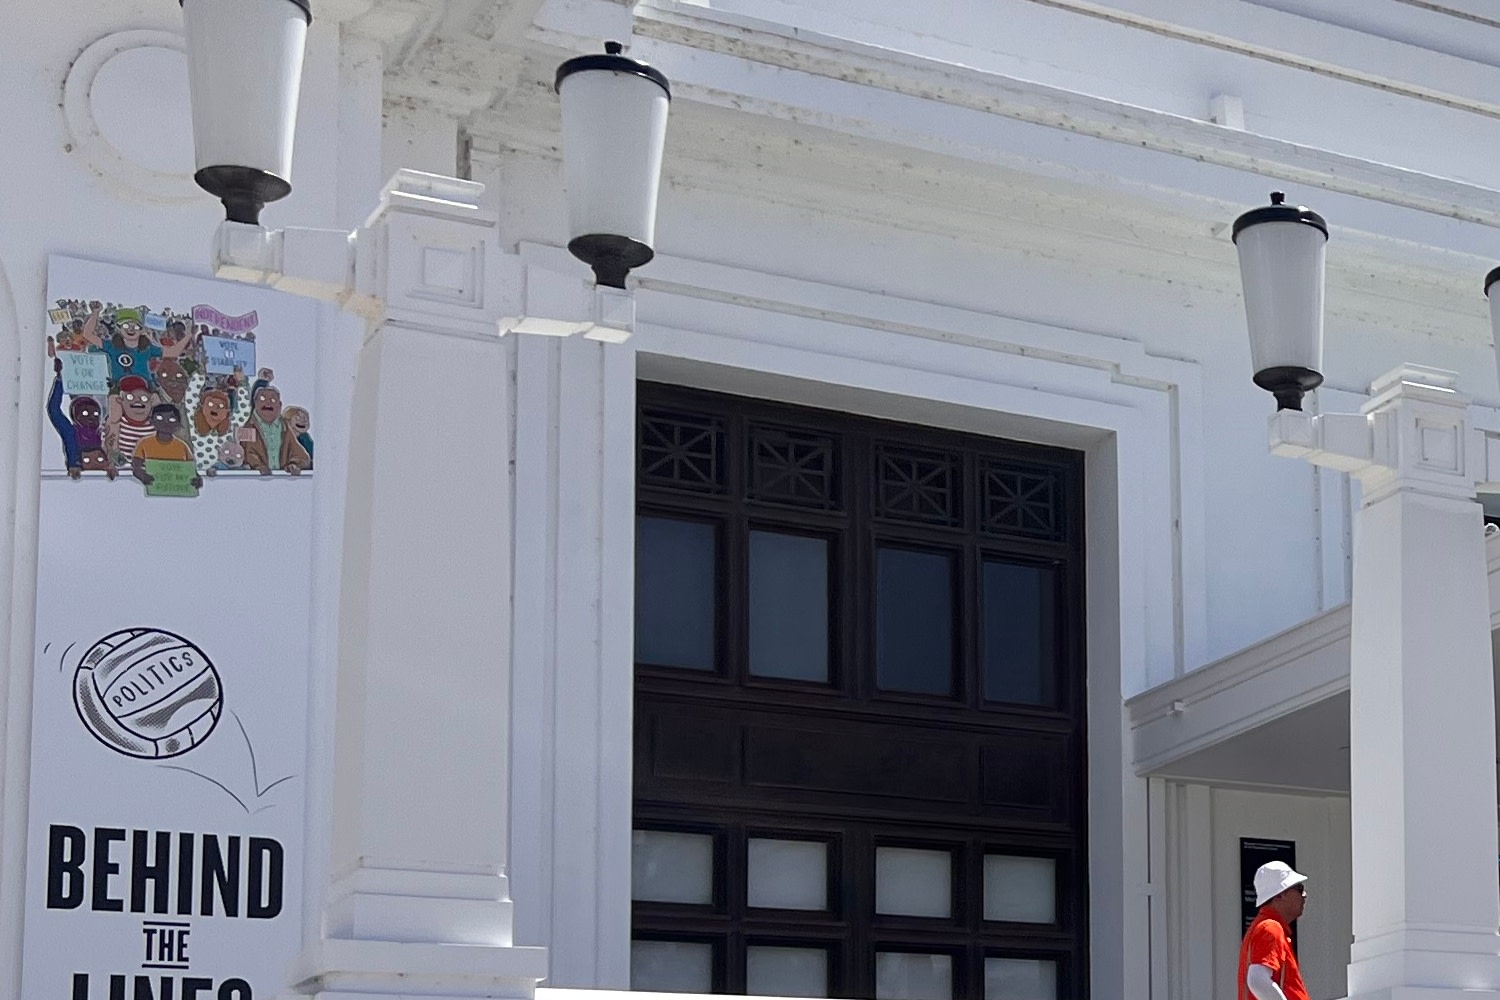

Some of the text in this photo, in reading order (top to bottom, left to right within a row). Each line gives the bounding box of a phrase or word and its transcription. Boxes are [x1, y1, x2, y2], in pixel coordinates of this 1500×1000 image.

[70, 354, 94, 365] VOTE
[67, 380, 106, 391] CHANGE
[112, 651, 194, 707] POLITICS
[47, 824, 284, 919] BEHIND
[142, 928, 190, 963] THE
